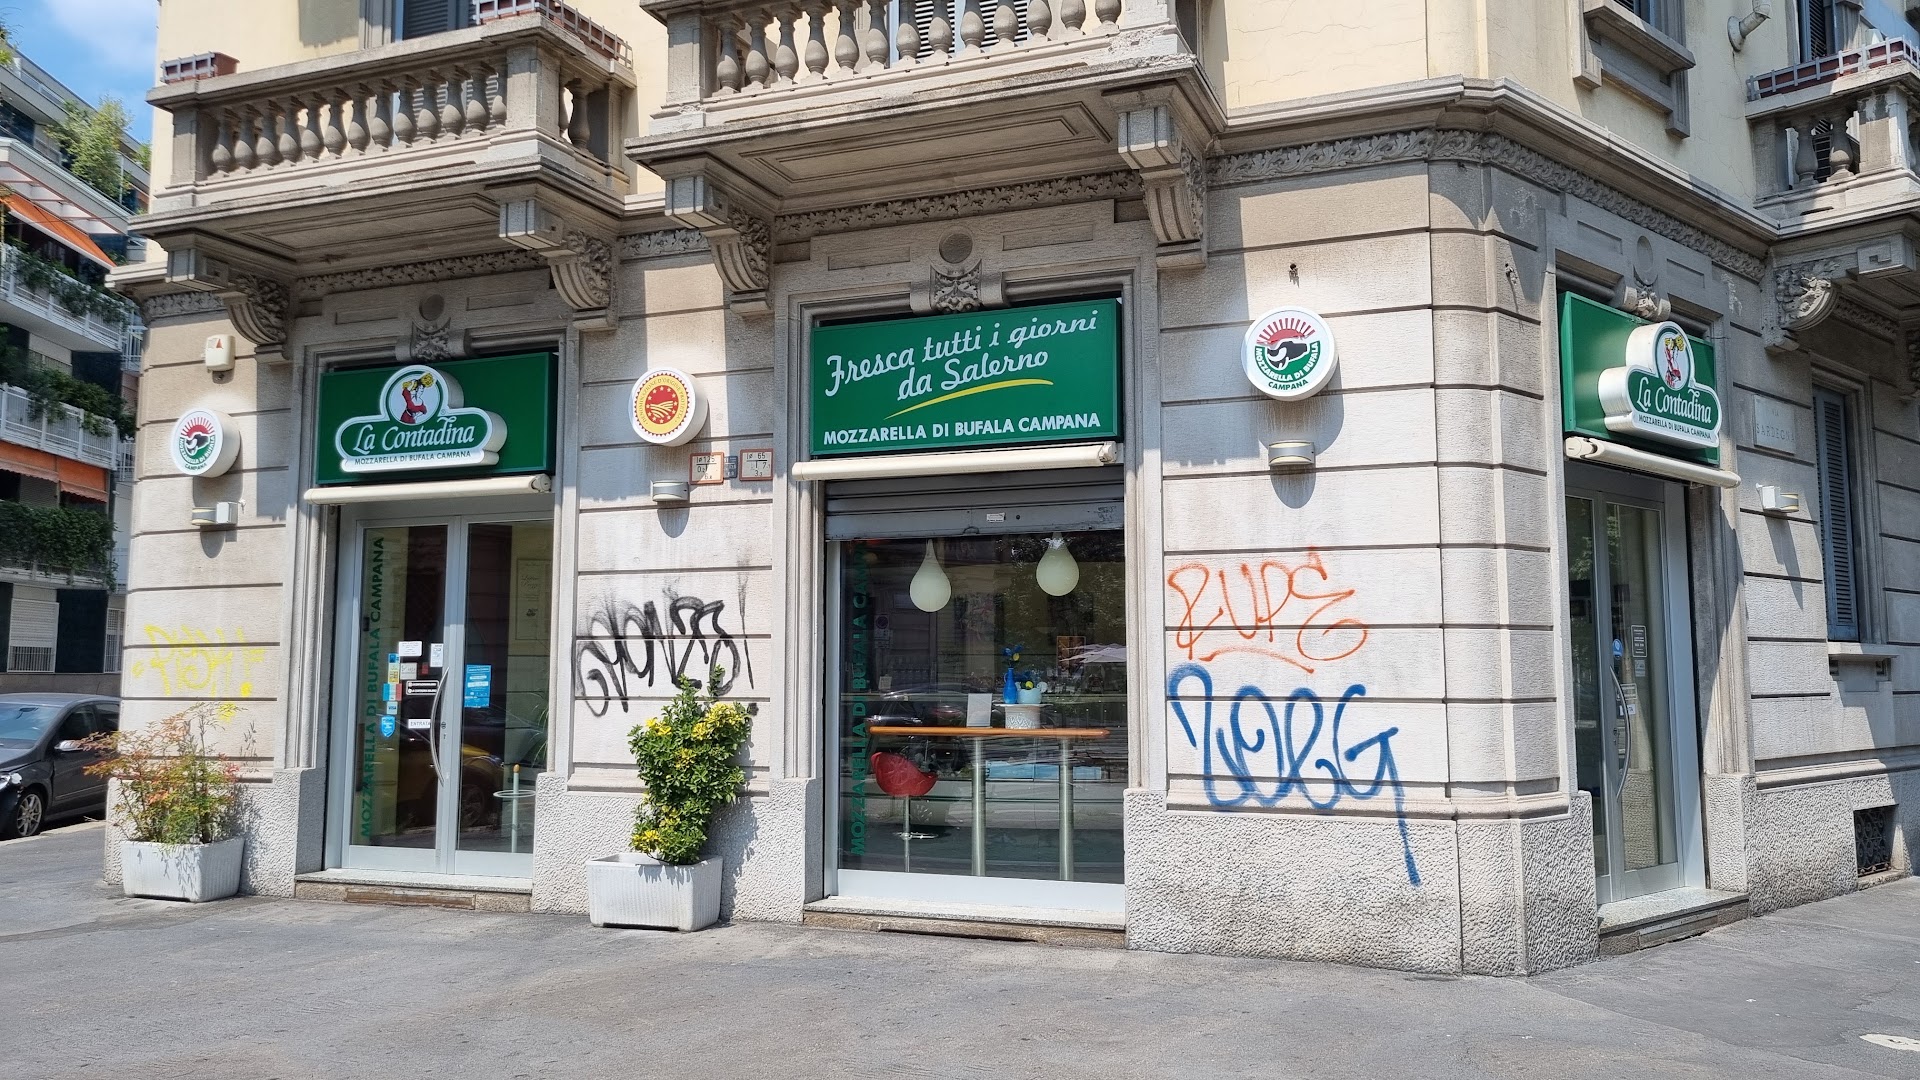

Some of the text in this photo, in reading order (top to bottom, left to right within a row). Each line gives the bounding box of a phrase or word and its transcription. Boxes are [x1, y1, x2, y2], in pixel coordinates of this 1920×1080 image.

[825, 310, 1098, 397] Fresca tutti i giorni
[1255, 341, 1319, 381] MOZZARELLA DI BUFALA
[897, 350, 1048, 401] da Salerno
[1269, 379, 1308, 390] CAMPANA
[1636, 376, 1711, 424] La Contadina
[353, 416, 475, 455] La Contadina
[823, 412, 1101, 445] MOZZARELLA DI BUFALA CAMPANA
[1638, 414, 1712, 440] MOZZARELLA DI BUFALA CAMPANA
[354, 451, 471, 465] MOZZARELLA DI BUFALA CAMPANA
[853, 615, 868, 689] BUFALA
[361, 537, 385, 837] MOZZARELLA DI BUFALA CAMPANA
[853, 697, 867, 717] DI
[850, 724, 867, 856] MOZZARELLA
